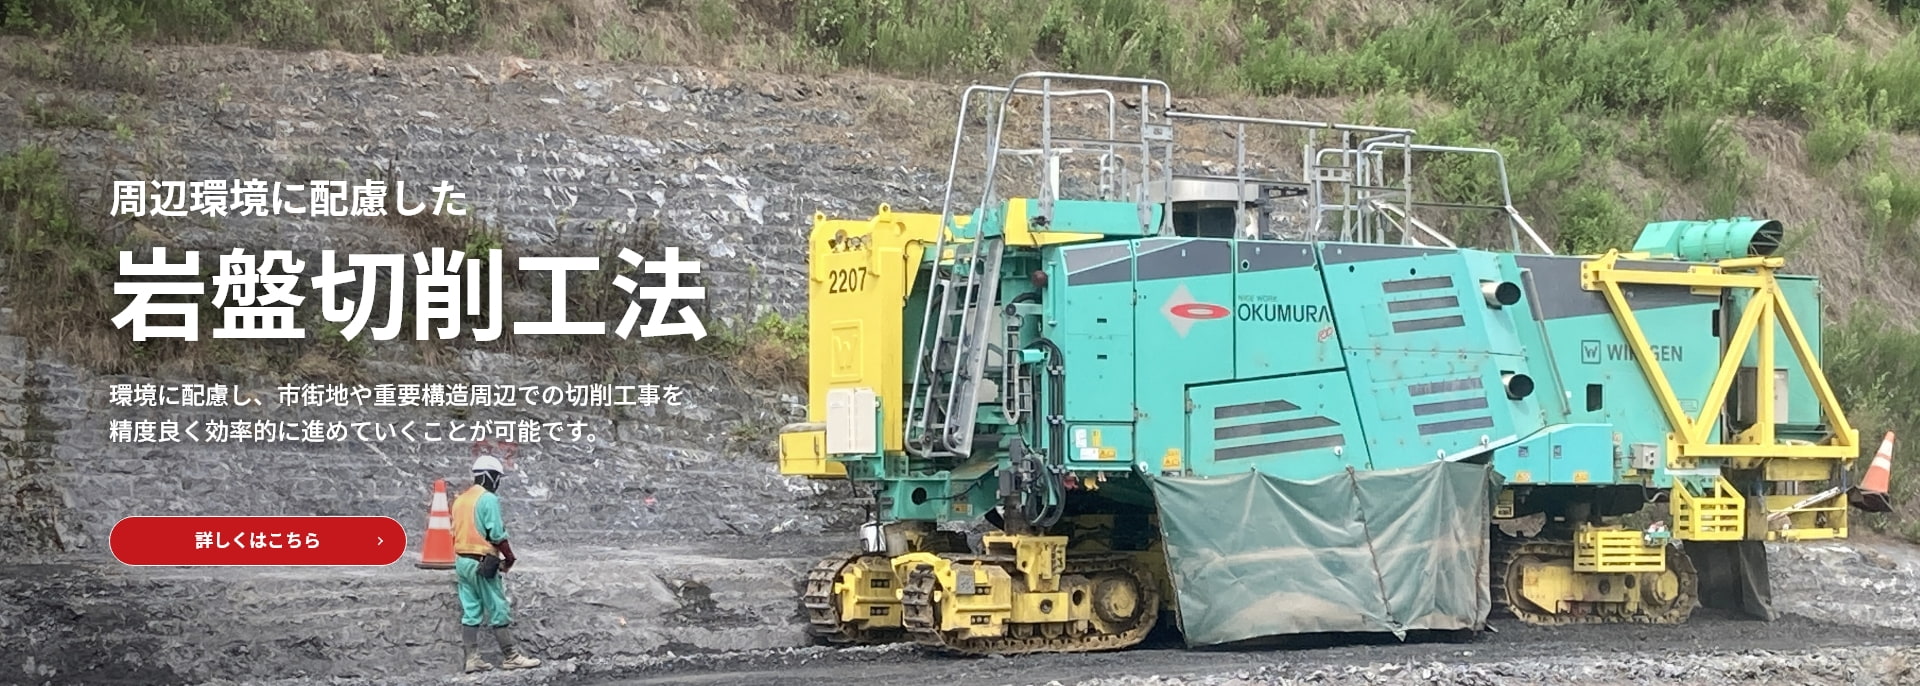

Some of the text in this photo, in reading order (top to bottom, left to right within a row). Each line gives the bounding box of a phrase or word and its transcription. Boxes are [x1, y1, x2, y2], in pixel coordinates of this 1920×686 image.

[829, 267, 867, 294] 2207
[1238, 303, 1330, 322] OKUMURA
[1607, 344, 1683, 362] WIGEN
